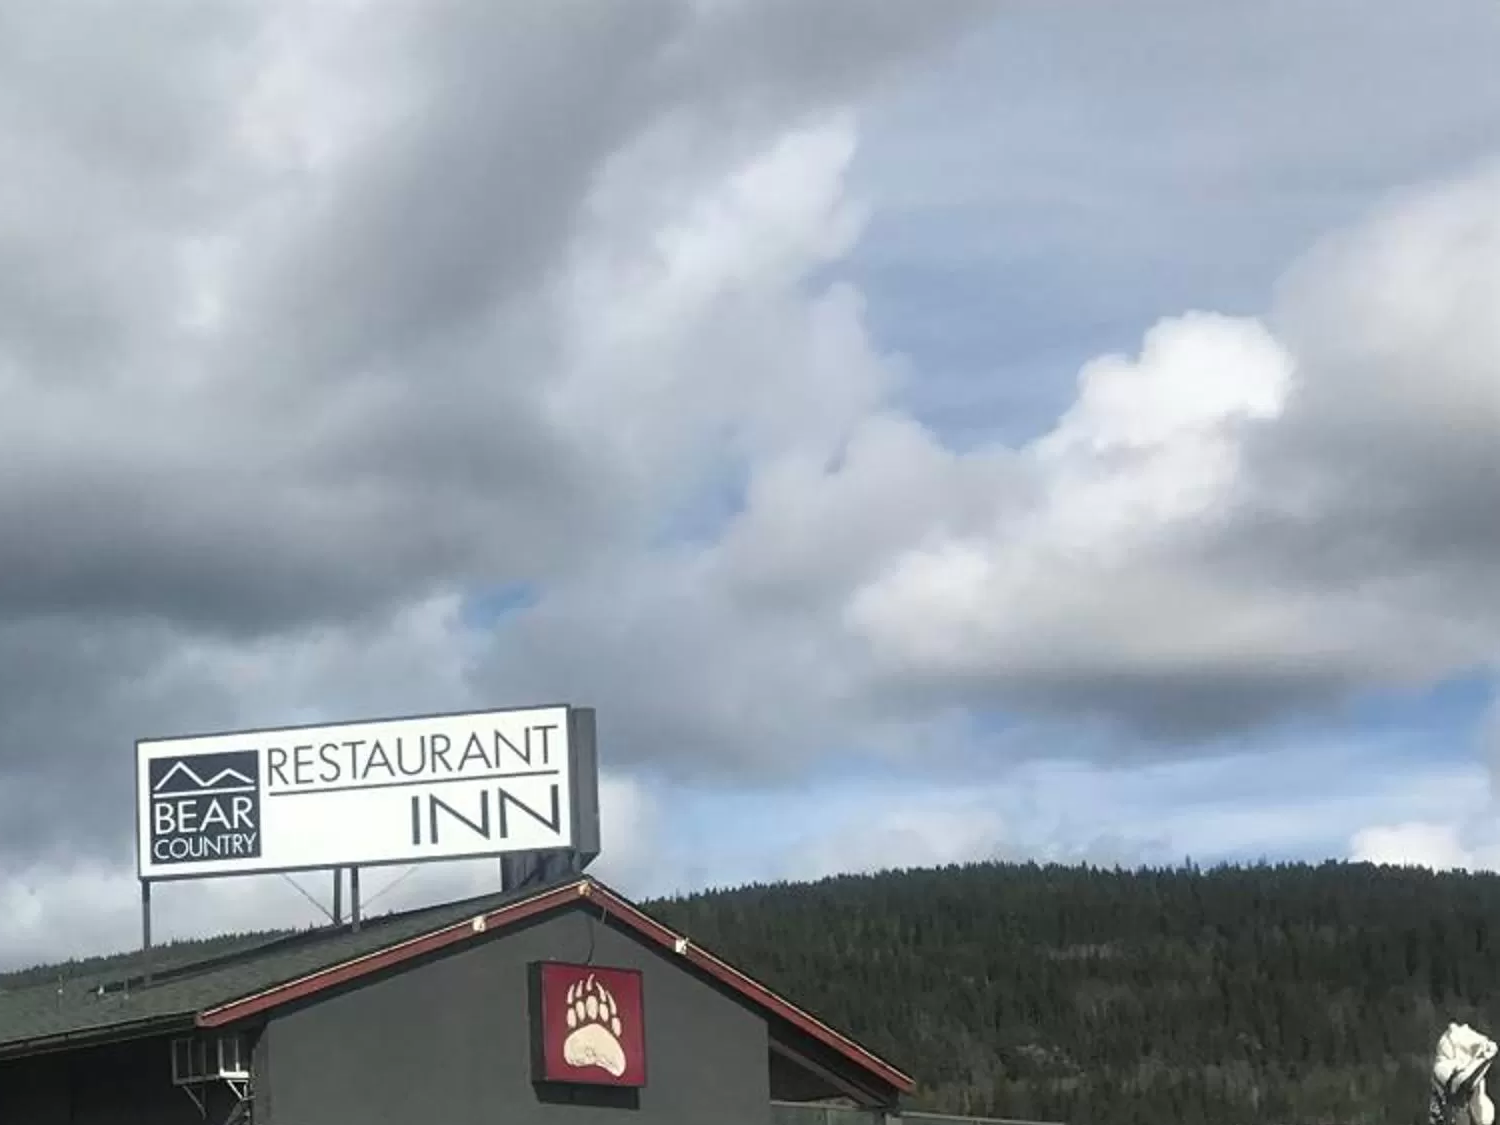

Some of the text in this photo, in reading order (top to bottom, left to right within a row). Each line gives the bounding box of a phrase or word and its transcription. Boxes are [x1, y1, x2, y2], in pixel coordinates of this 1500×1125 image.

[267, 724, 559, 787] RESTAURANT
[154, 796, 255, 835] BEAR
[411, 783, 561, 846] INN
[153, 832, 257, 860] COUNTRY
